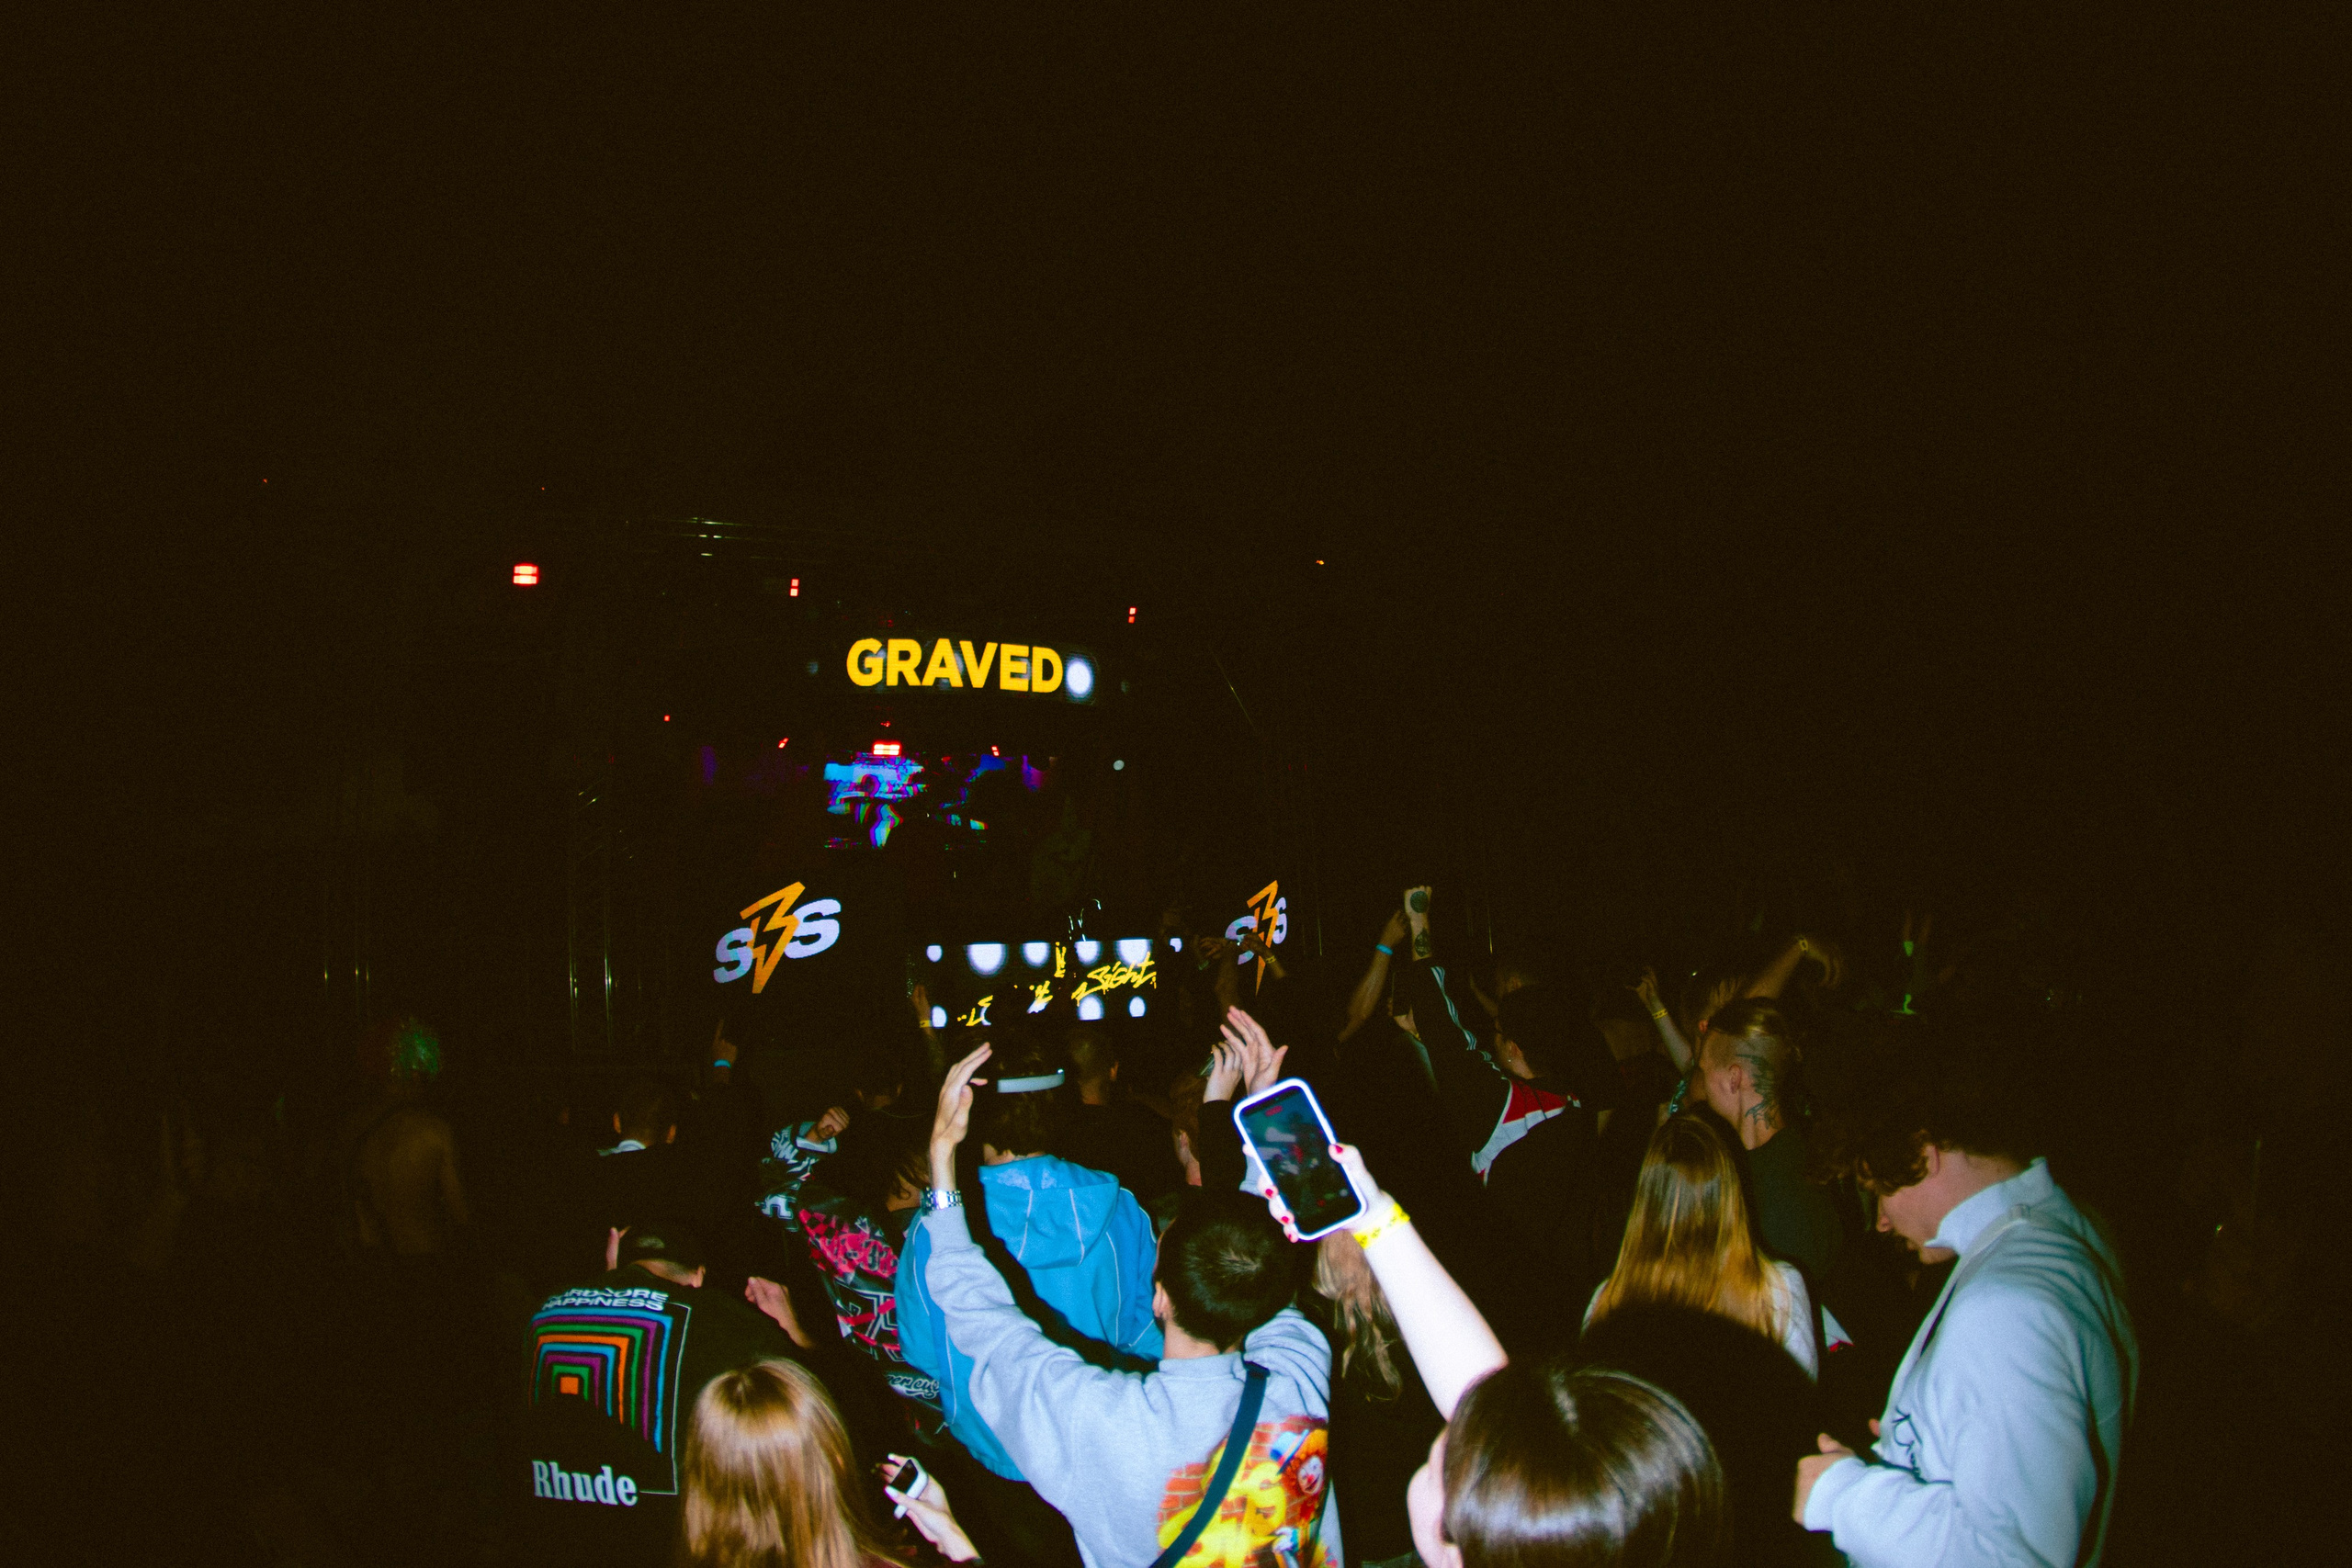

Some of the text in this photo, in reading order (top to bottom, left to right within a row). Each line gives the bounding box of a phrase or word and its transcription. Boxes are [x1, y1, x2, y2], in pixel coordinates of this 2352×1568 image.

[846, 637, 1064, 694] GRAVED
[541, 1296, 664, 1312] HAPPINESS
[532, 1460, 639, 1507] Rhude
